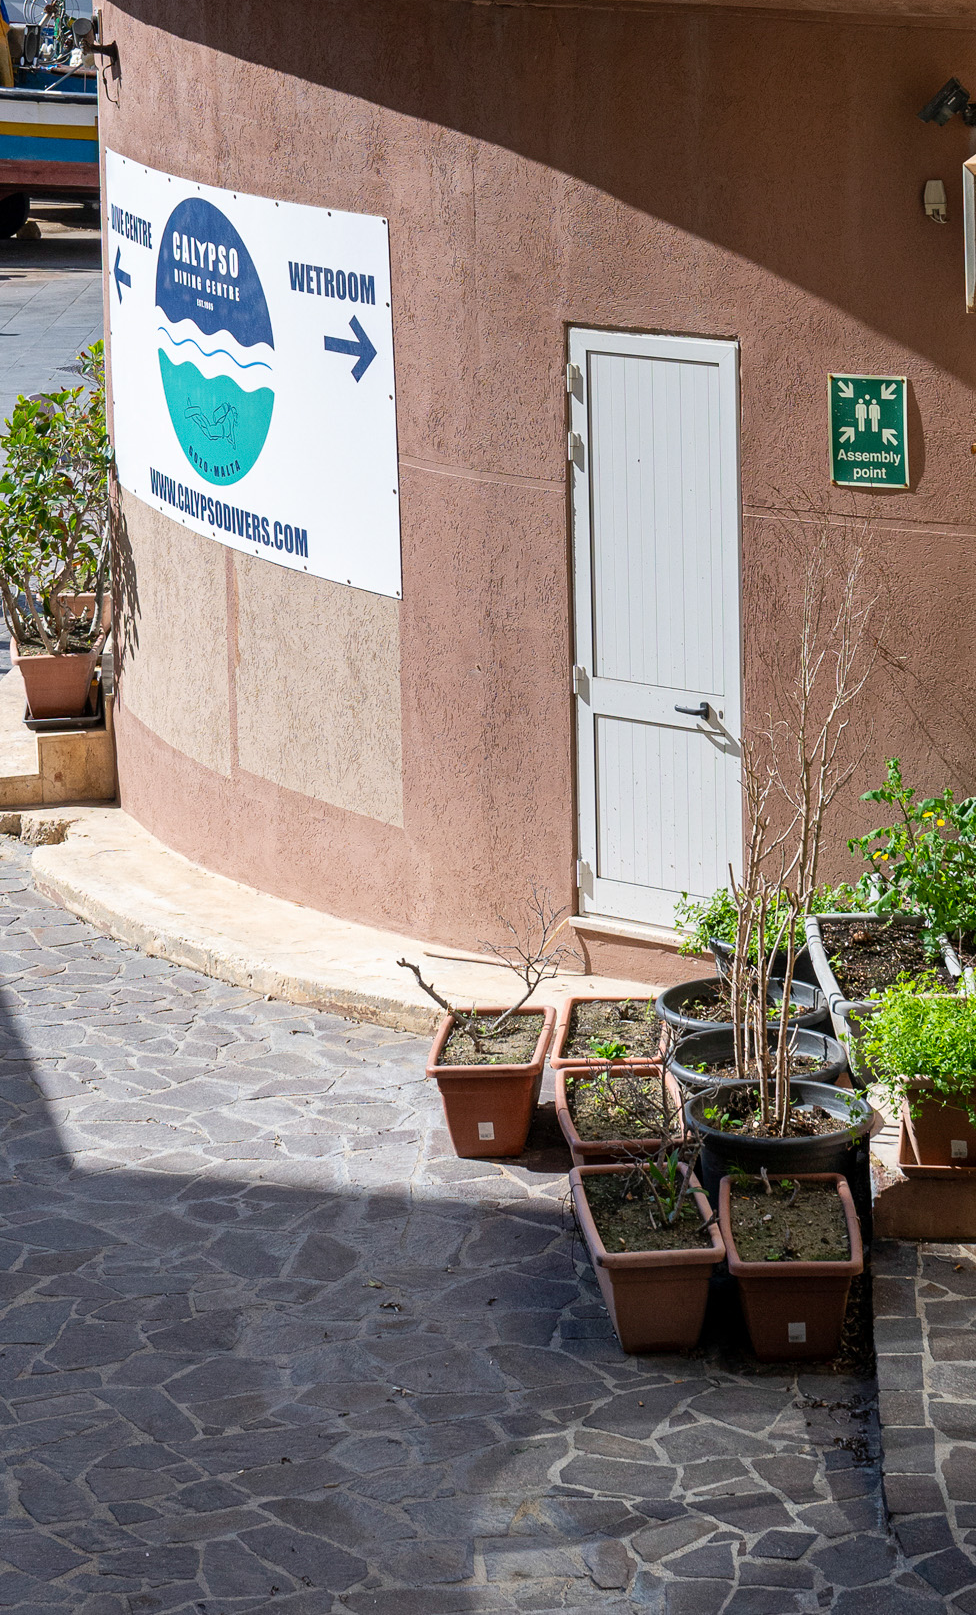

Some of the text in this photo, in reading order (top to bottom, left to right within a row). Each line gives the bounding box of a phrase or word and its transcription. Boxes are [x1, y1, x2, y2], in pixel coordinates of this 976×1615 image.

[111, 202, 153, 250] DIVE CENTRE
[172, 231, 239, 279] CALYPSO
[174, 268, 240, 302] DIVING CENTRE
[288, 260, 376, 306] WETROOM
[837, 448, 901, 466] Assembly
[853, 466, 887, 480] point
[149, 466, 309, 559] WWW.CALYPSODIVERS.COM
